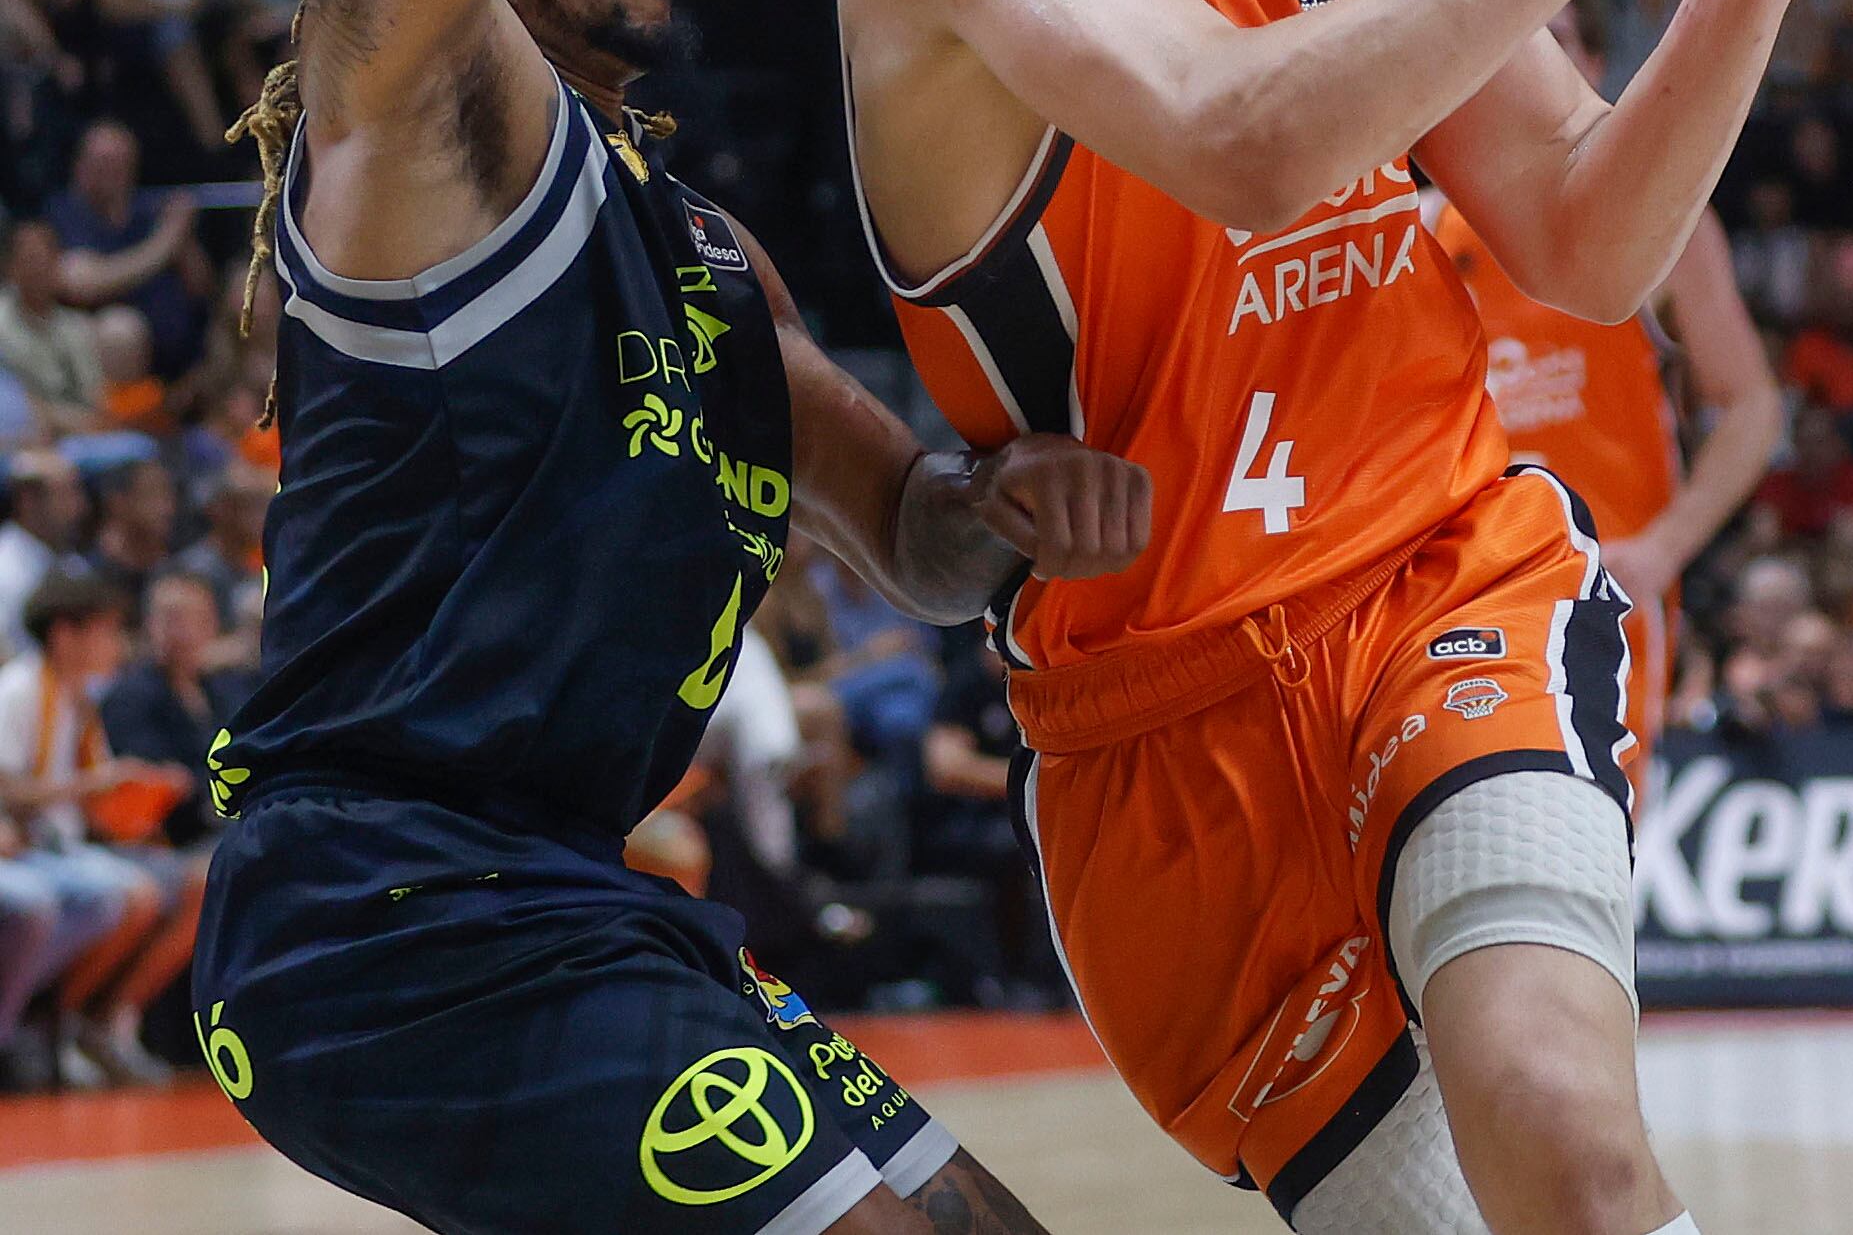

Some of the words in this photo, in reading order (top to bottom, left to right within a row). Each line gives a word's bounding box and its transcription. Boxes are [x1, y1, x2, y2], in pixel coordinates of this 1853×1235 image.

[1227, 223, 1416, 336] ARENA
[1222, 390, 1306, 535] 4
[1435, 637, 1487, 655] acb
[842, 1058, 884, 1107] del
